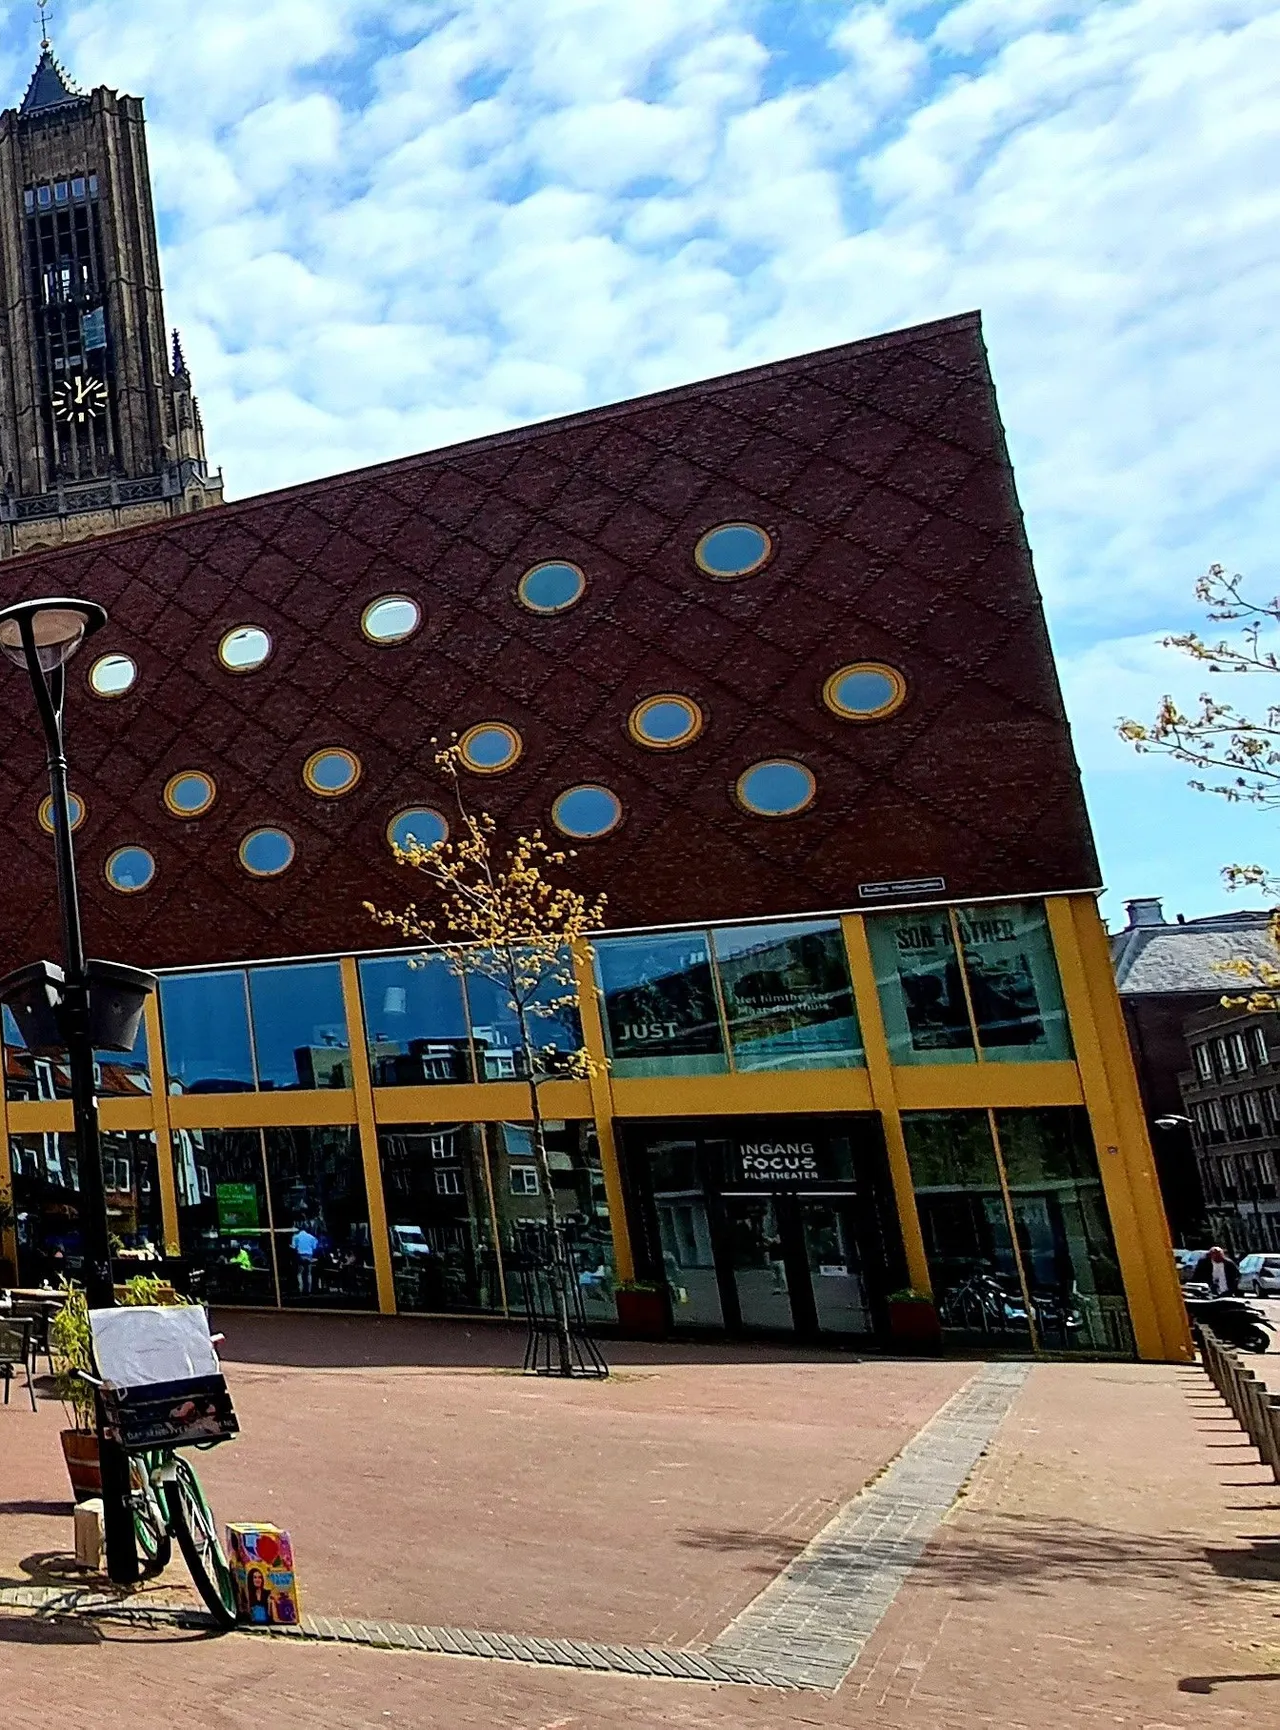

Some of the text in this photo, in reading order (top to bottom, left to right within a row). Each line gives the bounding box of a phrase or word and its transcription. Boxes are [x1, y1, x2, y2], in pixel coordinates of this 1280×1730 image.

[618, 1022, 678, 1040] JUST
[740, 1143, 815, 1155] INGANG
[742, 1156, 817, 1169] FOCUS
[744, 1171, 819, 1180] FILMTHEATER
